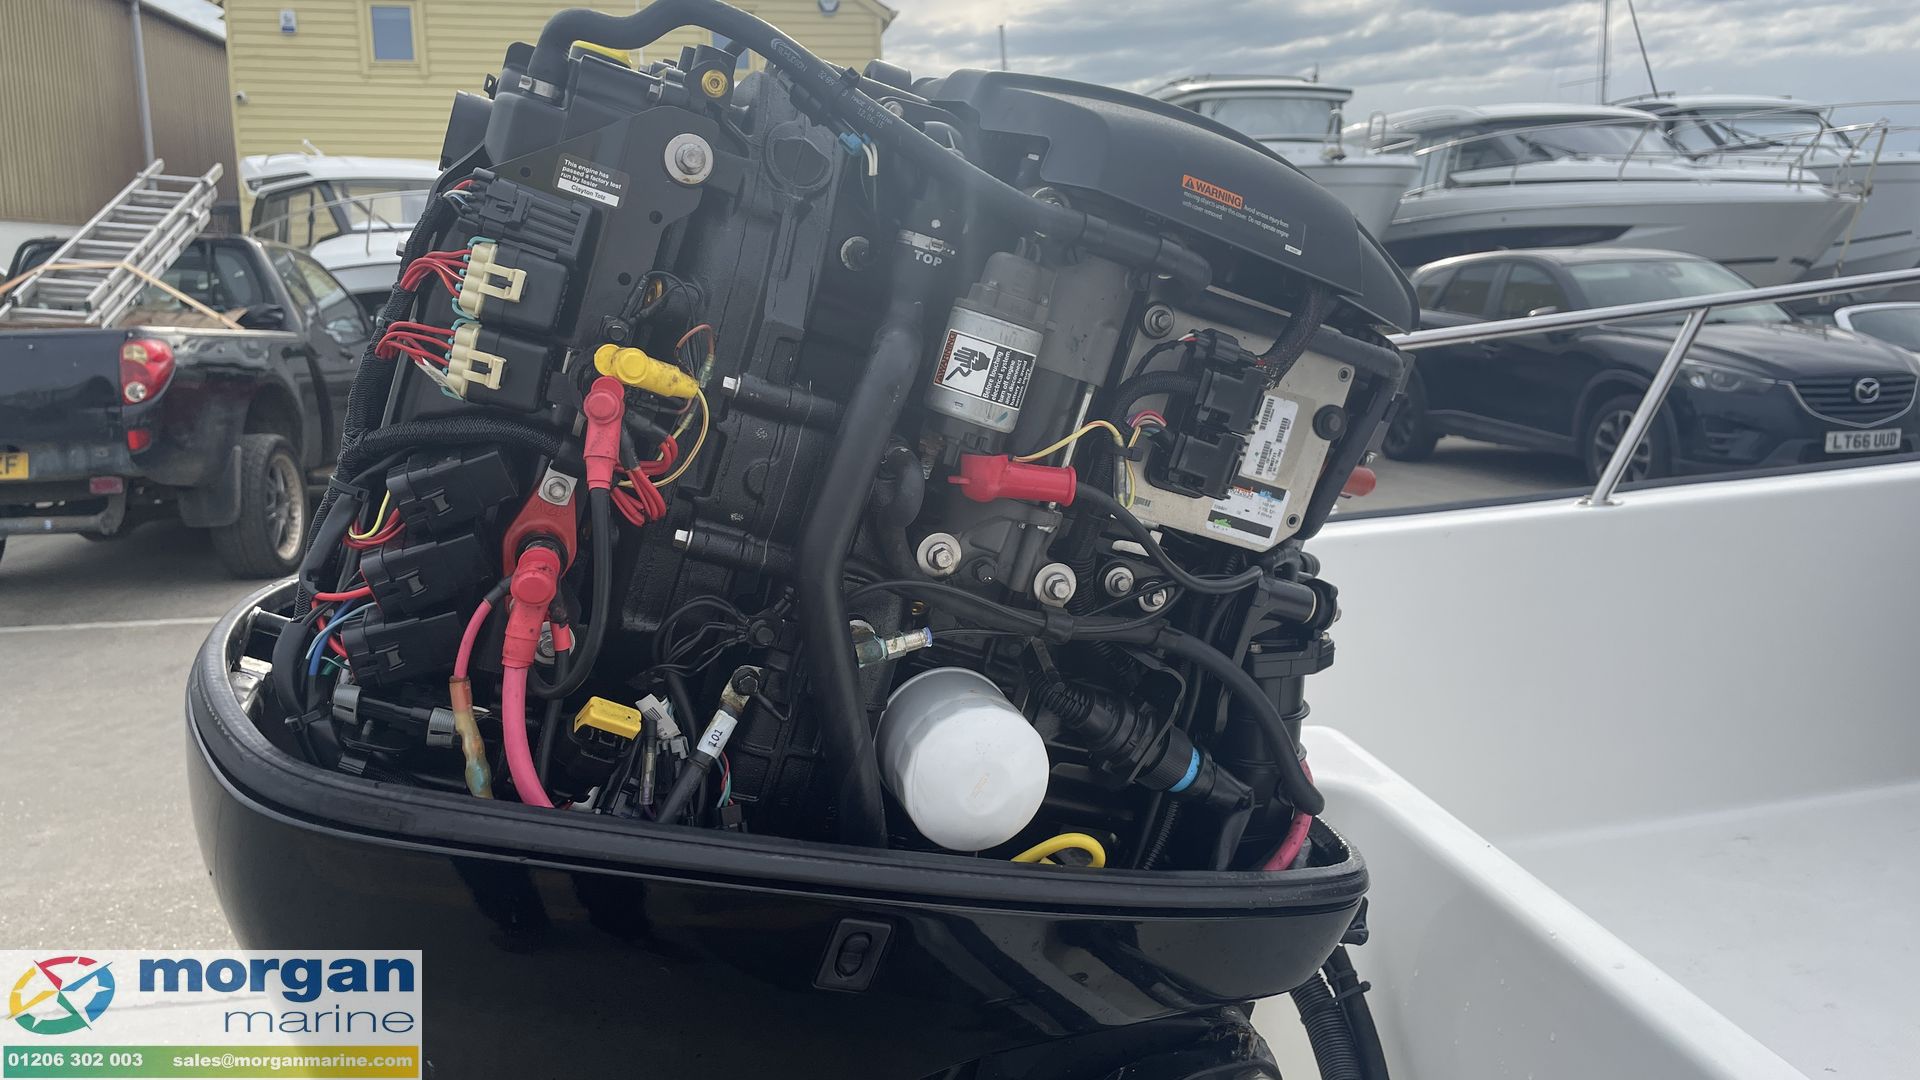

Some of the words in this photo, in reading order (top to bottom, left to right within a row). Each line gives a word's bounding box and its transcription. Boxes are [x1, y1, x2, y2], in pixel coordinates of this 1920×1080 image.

[562, 166, 585, 177] passed
[590, 174, 610, 186] factory
[610, 181, 622, 190] test
[564, 159, 577, 168] This
[578, 164, 598, 175] engine
[571, 184, 594, 196] Clayton
[572, 175, 580, 183] by
[581, 178, 598, 188] tester
[1196, 182, 1242, 207] WARNING
[914, 250, 942, 266] TOP
[937, 332, 957, 375] WARNING
[982, 379, 994, 398] Before
[992, 350, 1004, 378] touching
[992, 373, 1004, 400] electrical
[1000, 350, 1012, 372] system,
[998, 388, 1006, 402] turn
[1006, 360, 1016, 380] engine
[1009, 360, 1022, 392] disconnect
[1010, 385, 1019, 406] battery
[1019, 360, 1028, 376] avoid
[1833, 434, 1871, 449] LT66
[1874, 432, 1897, 448] UUD
[708, 729, 723, 748] 101
